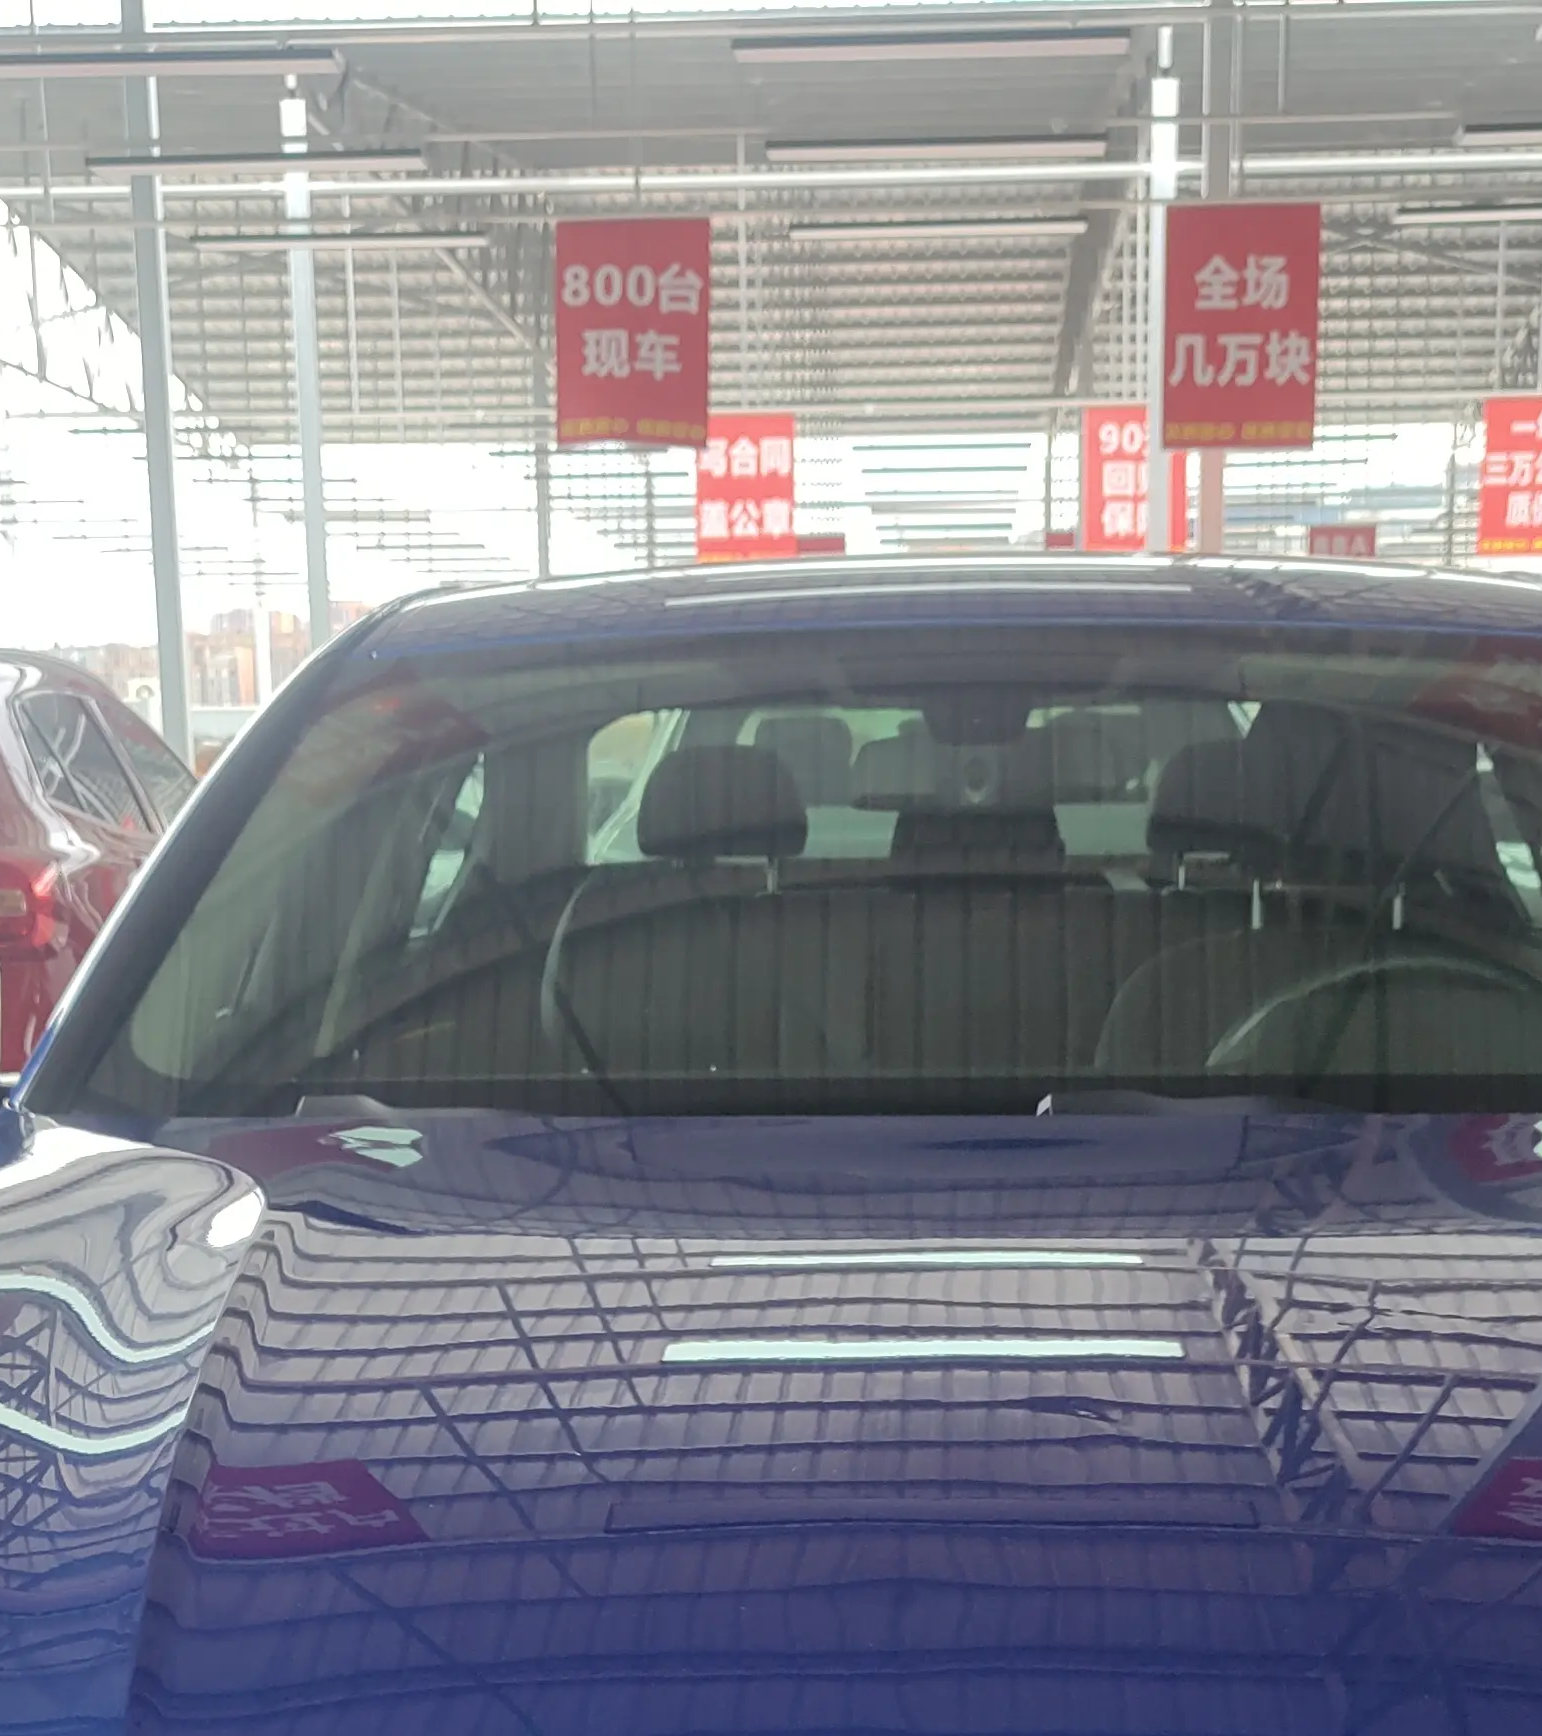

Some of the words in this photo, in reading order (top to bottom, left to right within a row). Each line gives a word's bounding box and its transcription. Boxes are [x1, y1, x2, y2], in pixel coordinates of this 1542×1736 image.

[561, 262, 705, 315] 800台
[1194, 252, 1290, 310] 全场
[581, 328, 682, 381] 现车
[1168, 328, 1312, 387] 几万块
[1098, 421, 1150, 456] 90
